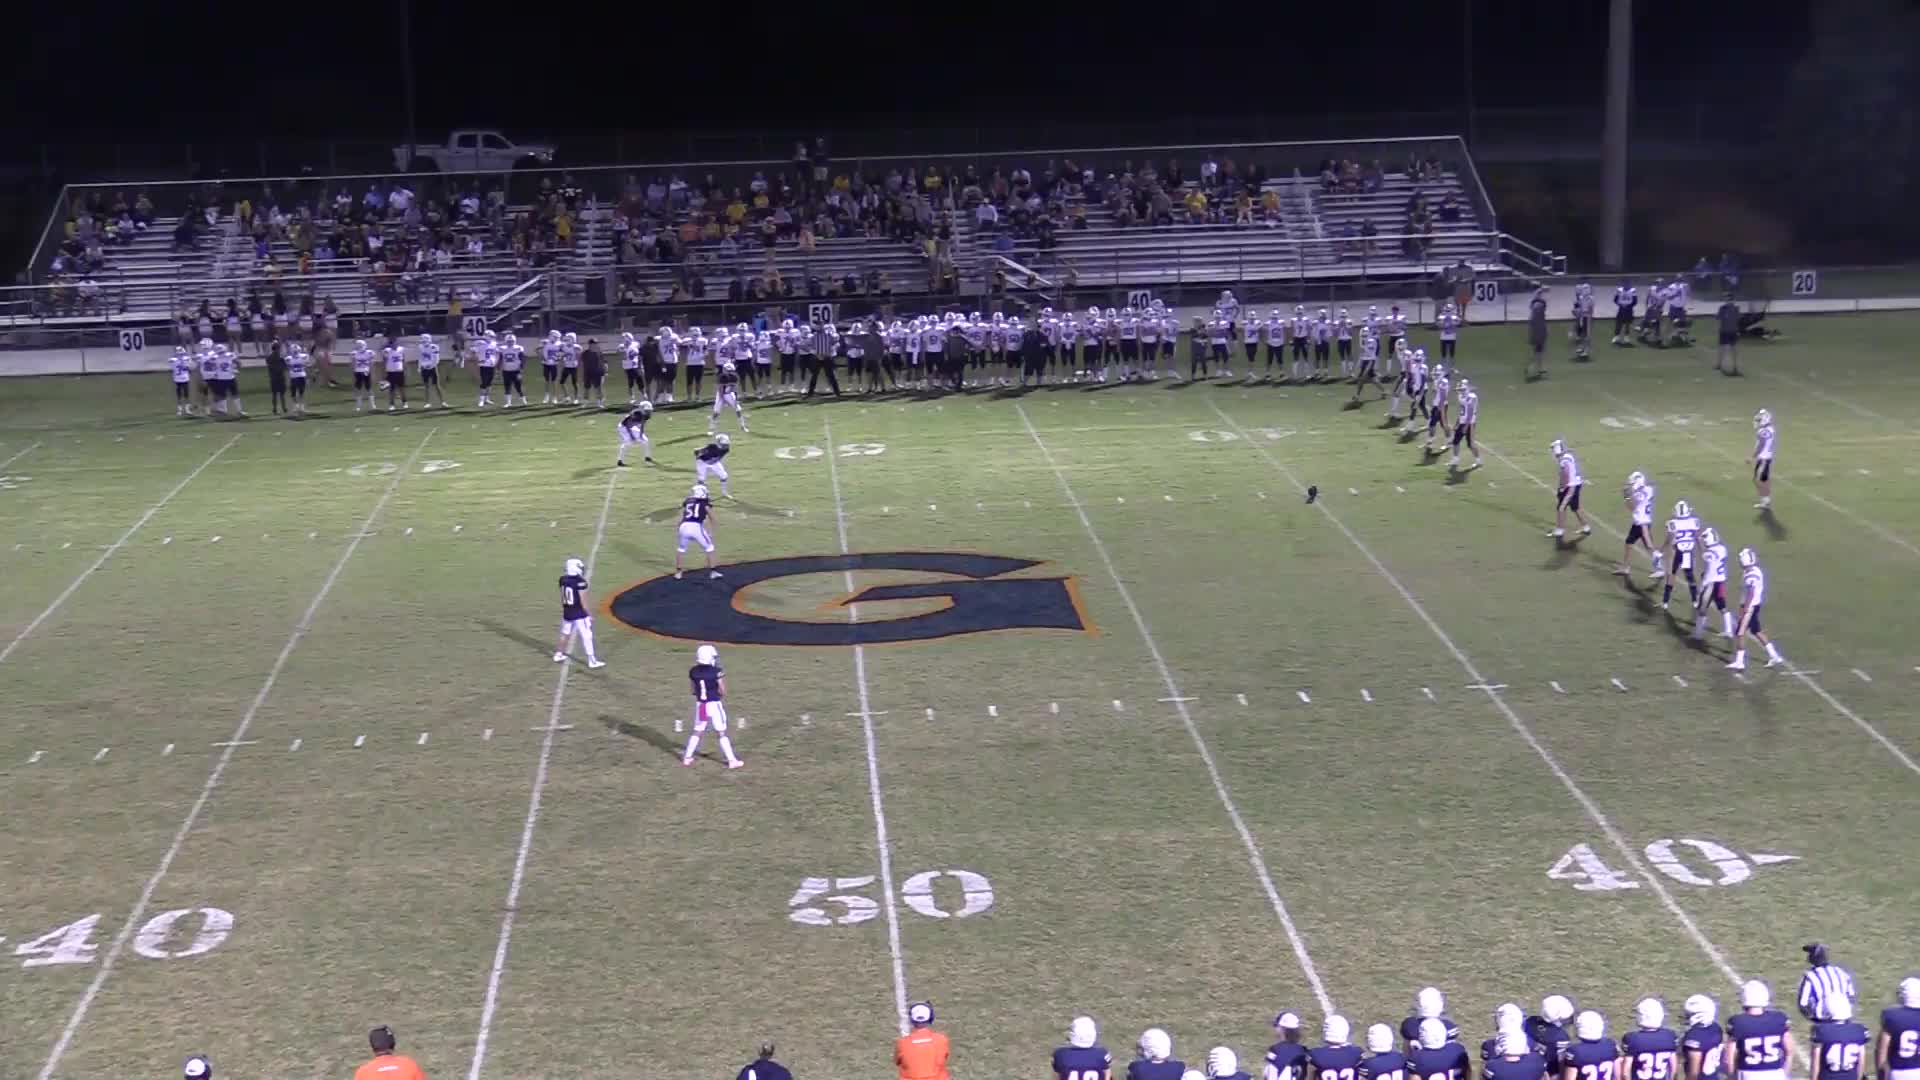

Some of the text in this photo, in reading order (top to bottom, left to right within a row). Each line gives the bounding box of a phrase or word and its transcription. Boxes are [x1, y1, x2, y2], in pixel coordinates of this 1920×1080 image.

[1477, 283, 1495, 302] 30
[1795, 274, 1813, 292] 20
[1131, 293, 1149, 310] 40
[812, 306, 830, 326] 50
[466, 317, 485, 337] 40
[122, 332, 143, 351] 30
[685, 503, 700, 518] 51
[598, 551, 1099, 646] G
[699, 679, 708, 700] 1
[1545, 839, 1751, 891] 40
[788, 869, 994, 925] 50
[14, 907, 235, 968] 40
[1744, 1035, 1781, 1065] 55
[1636, 1051, 1672, 1080] 35
